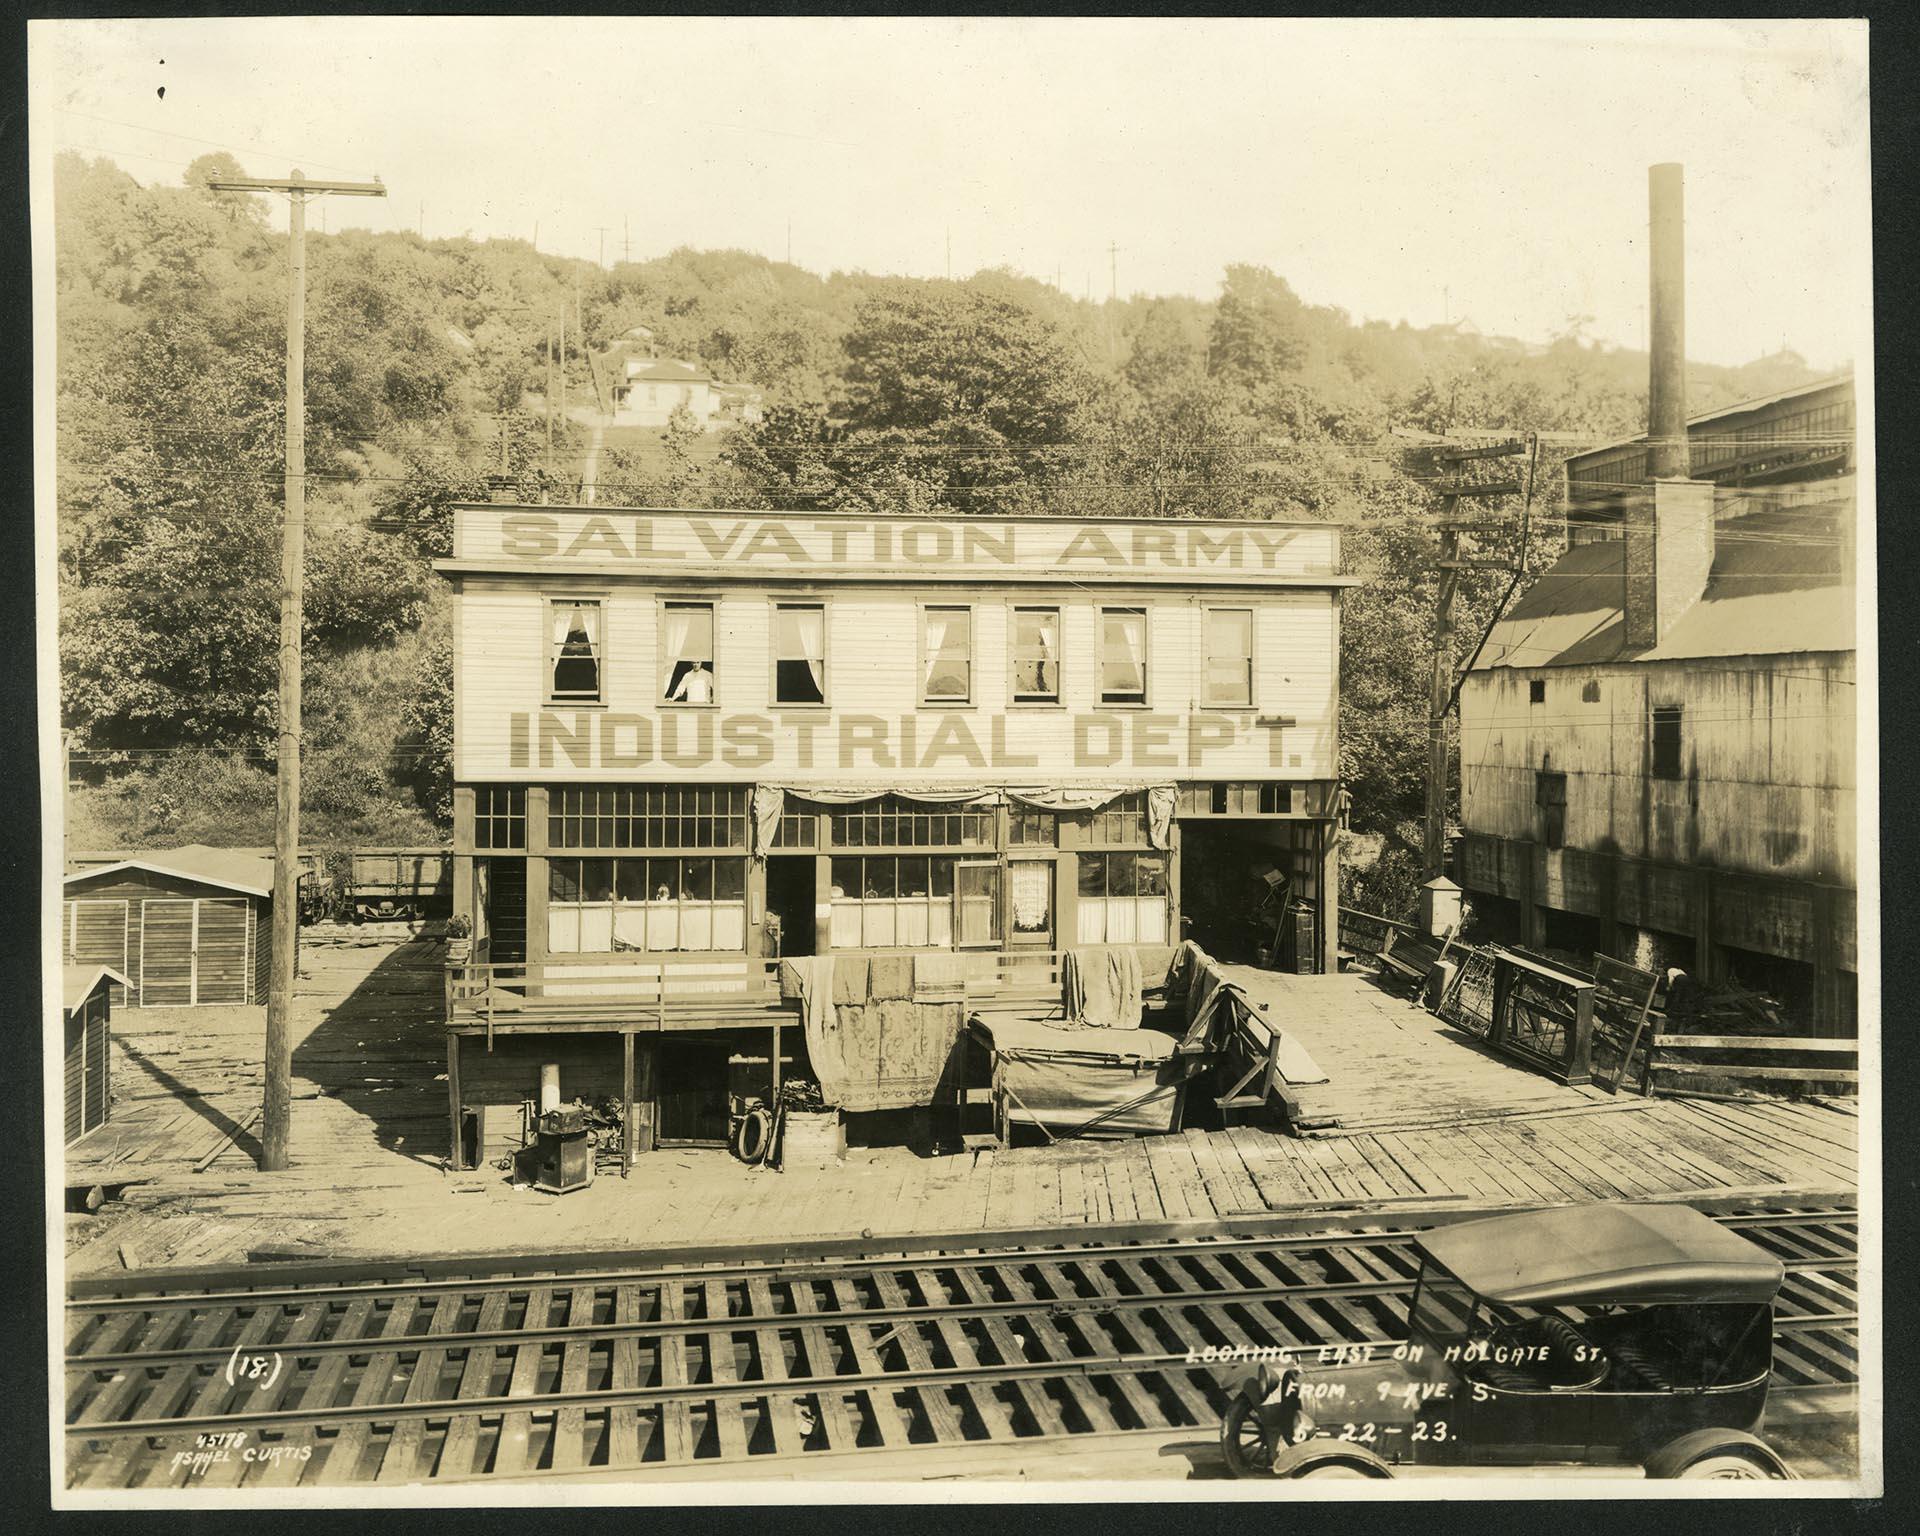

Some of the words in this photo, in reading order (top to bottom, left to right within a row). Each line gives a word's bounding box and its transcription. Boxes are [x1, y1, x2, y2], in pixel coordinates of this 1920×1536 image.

[501, 514, 1017, 565] SALVATION
[1055, 526, 1302, 569] ARMY
[509, 712, 1039, 769] INDUSTRIAL
